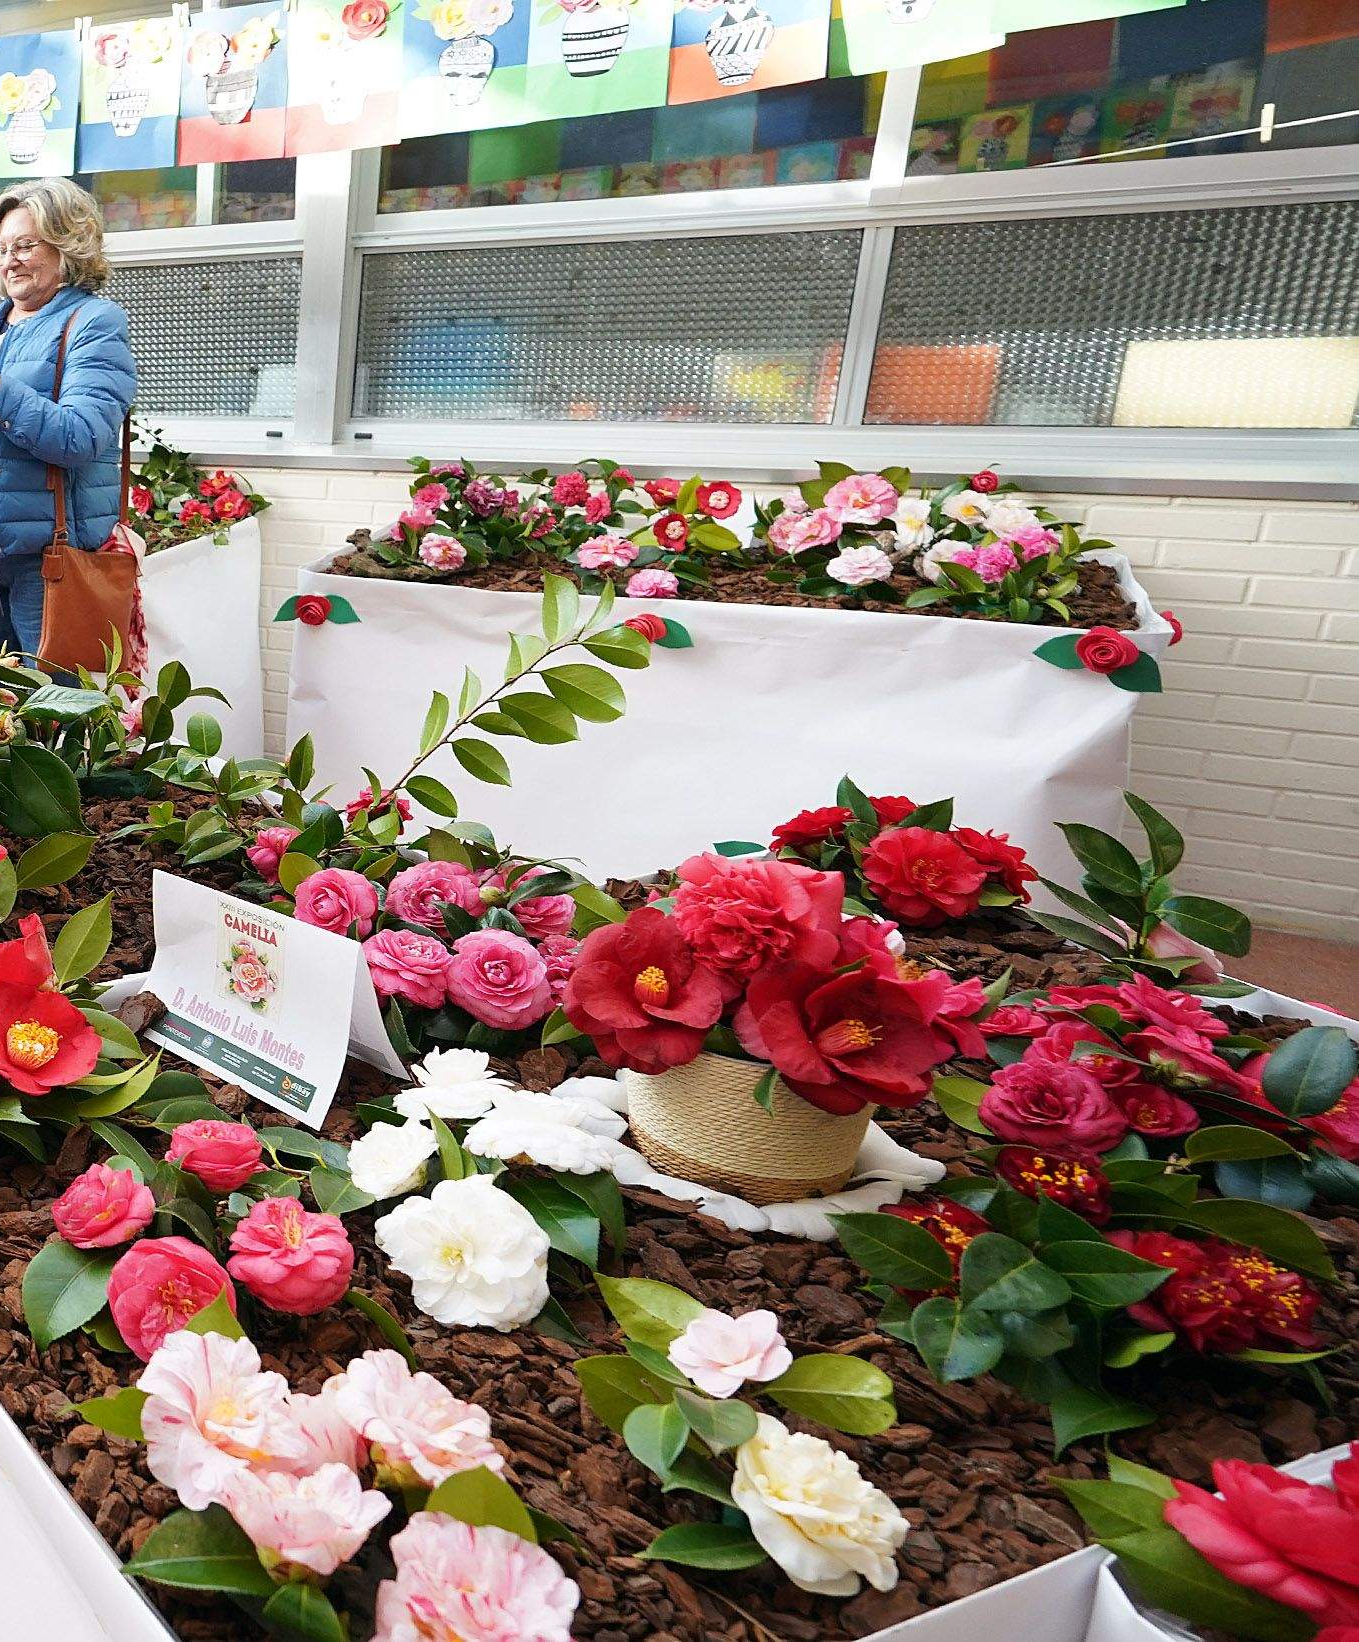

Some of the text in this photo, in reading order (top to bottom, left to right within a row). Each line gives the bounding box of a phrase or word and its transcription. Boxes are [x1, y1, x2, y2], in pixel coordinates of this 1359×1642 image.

[224, 913, 278, 947] CAMELIA
[236, 907, 286, 931] EXPOSICIÓN
[171, 986, 184, 1009] D.
[185, 994, 232, 1033] Antonio
[230, 1015, 259, 1046] Luis
[258, 1029, 306, 1070] Montes
